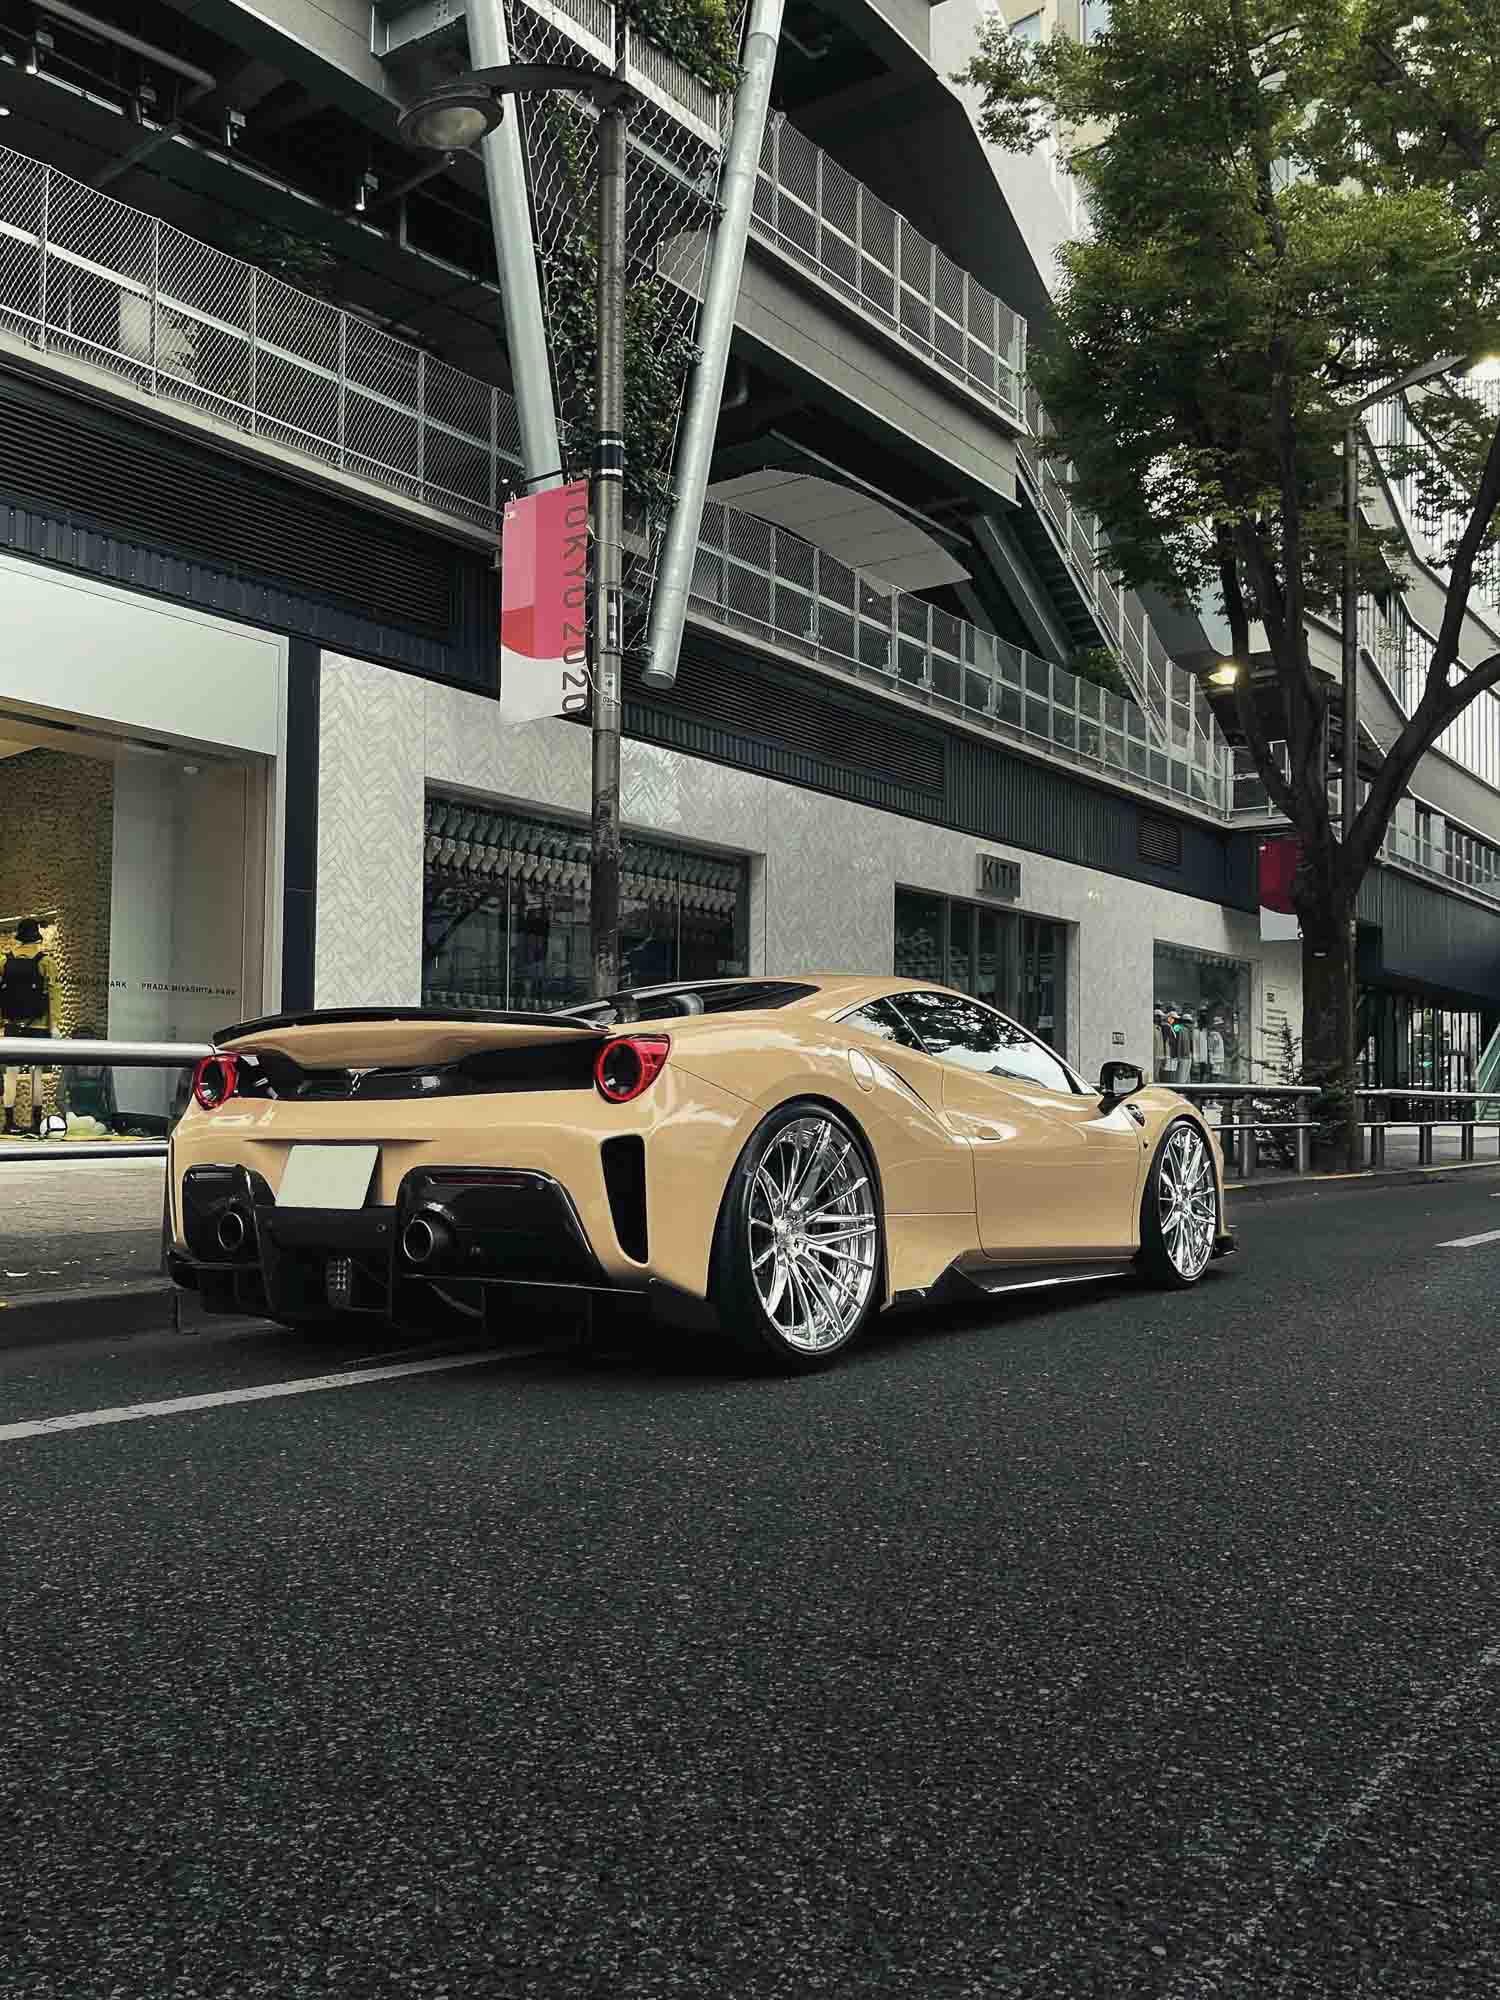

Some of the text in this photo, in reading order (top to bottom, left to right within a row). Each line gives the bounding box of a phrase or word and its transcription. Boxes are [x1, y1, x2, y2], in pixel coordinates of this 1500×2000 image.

[562, 482, 588, 713] TOKYO 2020
[984, 858, 1019, 888] KITH
[141, 982, 169, 991] PRADA
[171, 984, 213, 994] MIYASHITA
